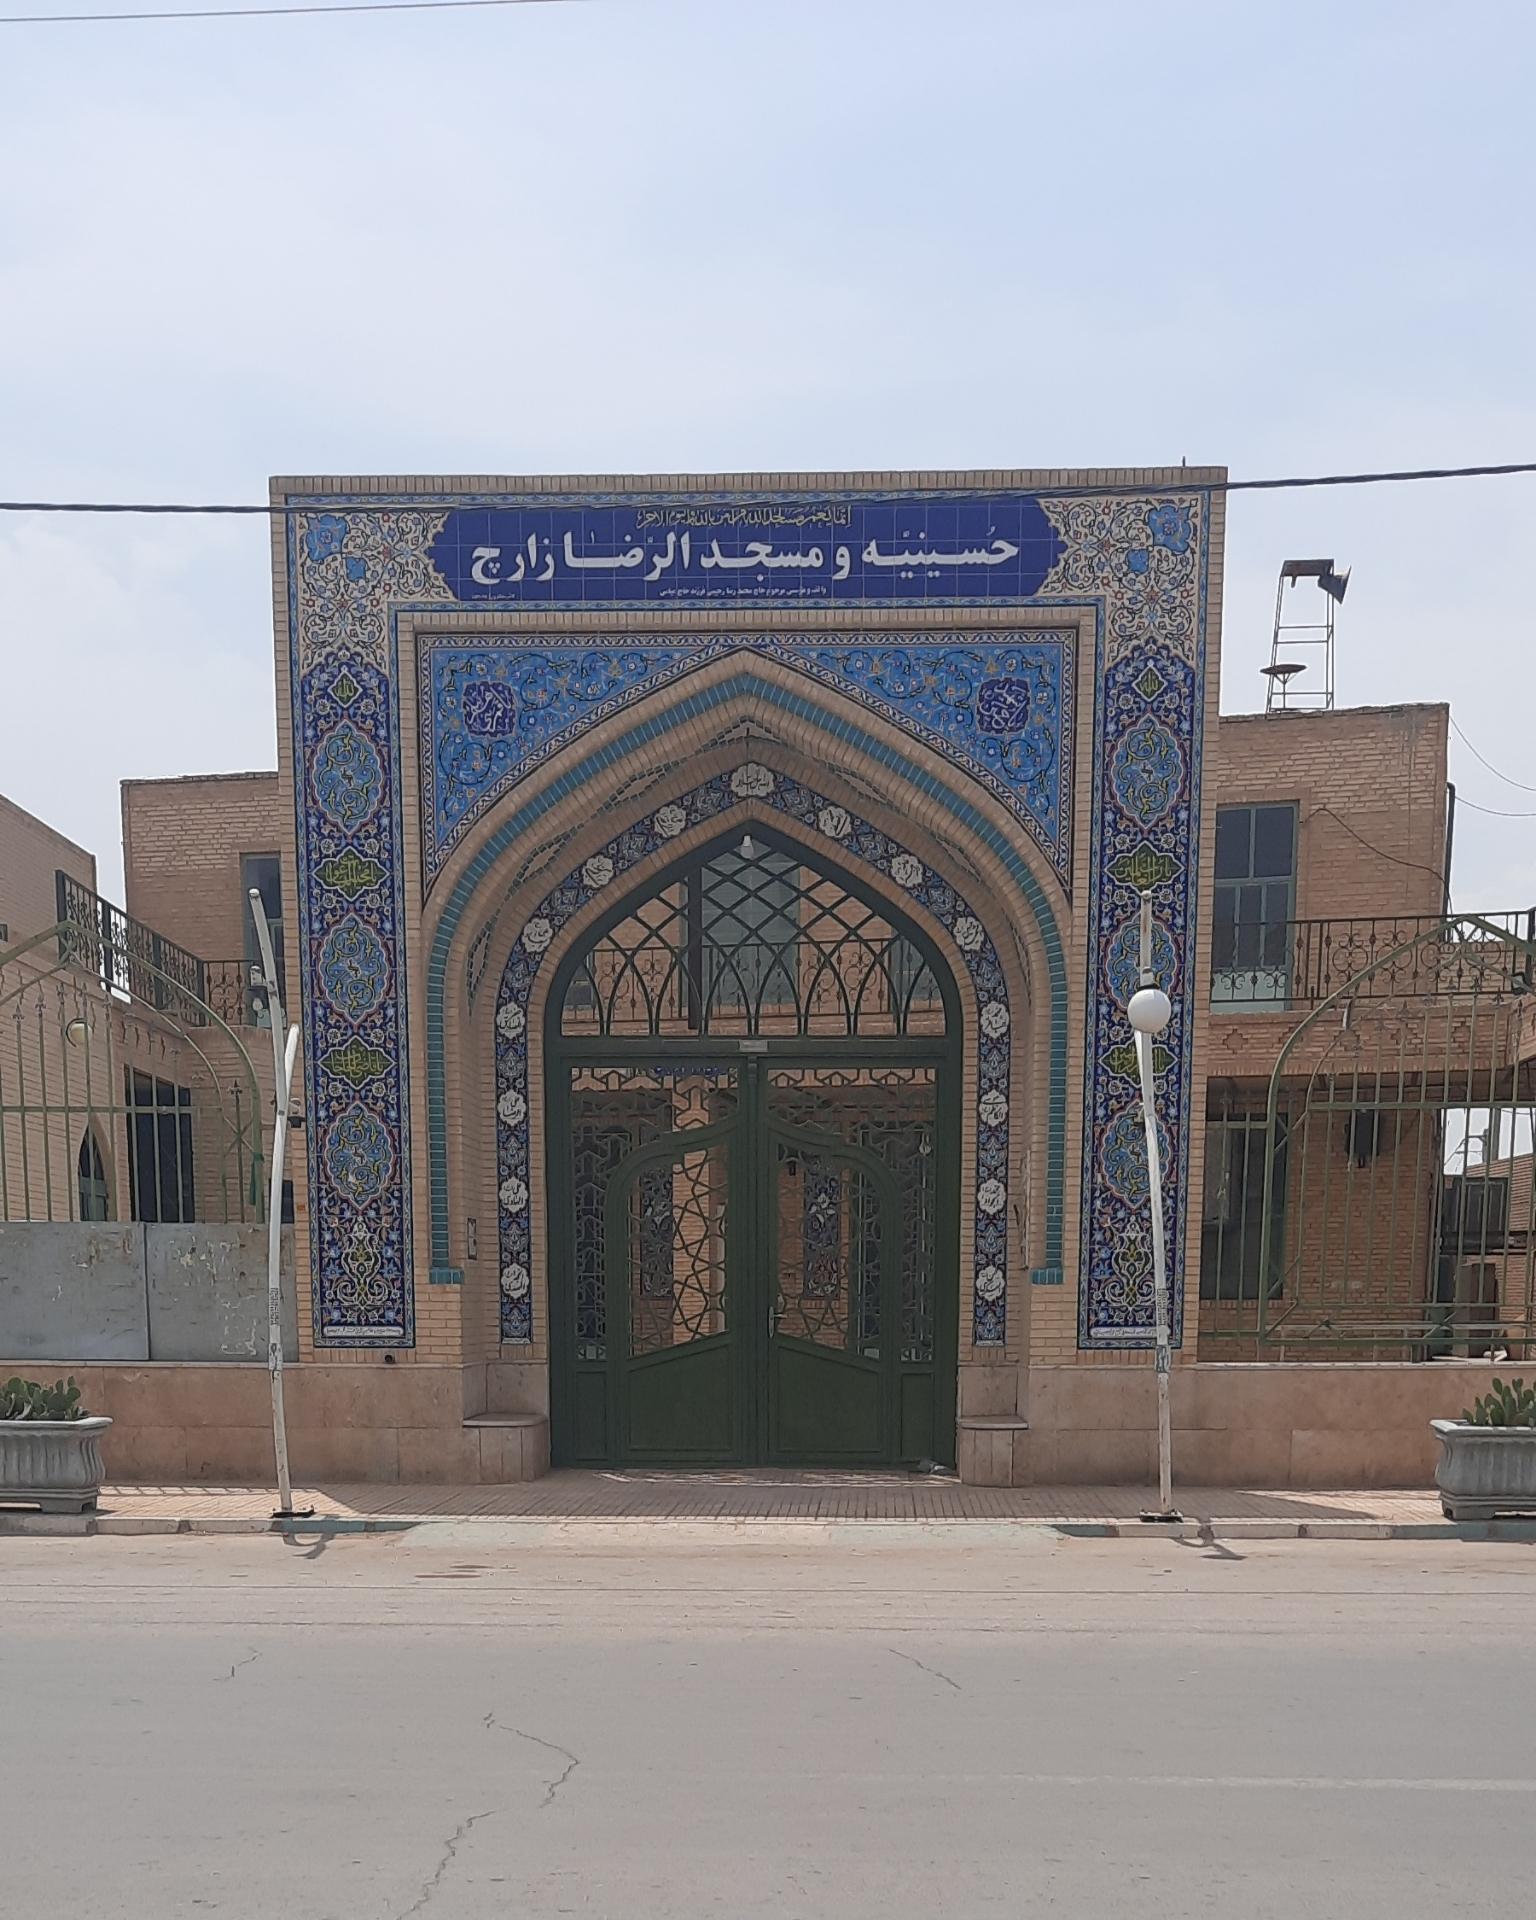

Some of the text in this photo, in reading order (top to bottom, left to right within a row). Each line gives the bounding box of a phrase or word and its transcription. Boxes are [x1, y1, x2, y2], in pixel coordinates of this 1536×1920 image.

[470, 531, 555, 585] زارچ
[699, 538, 825, 582] مسجد
[832, 545, 851, 581] و
